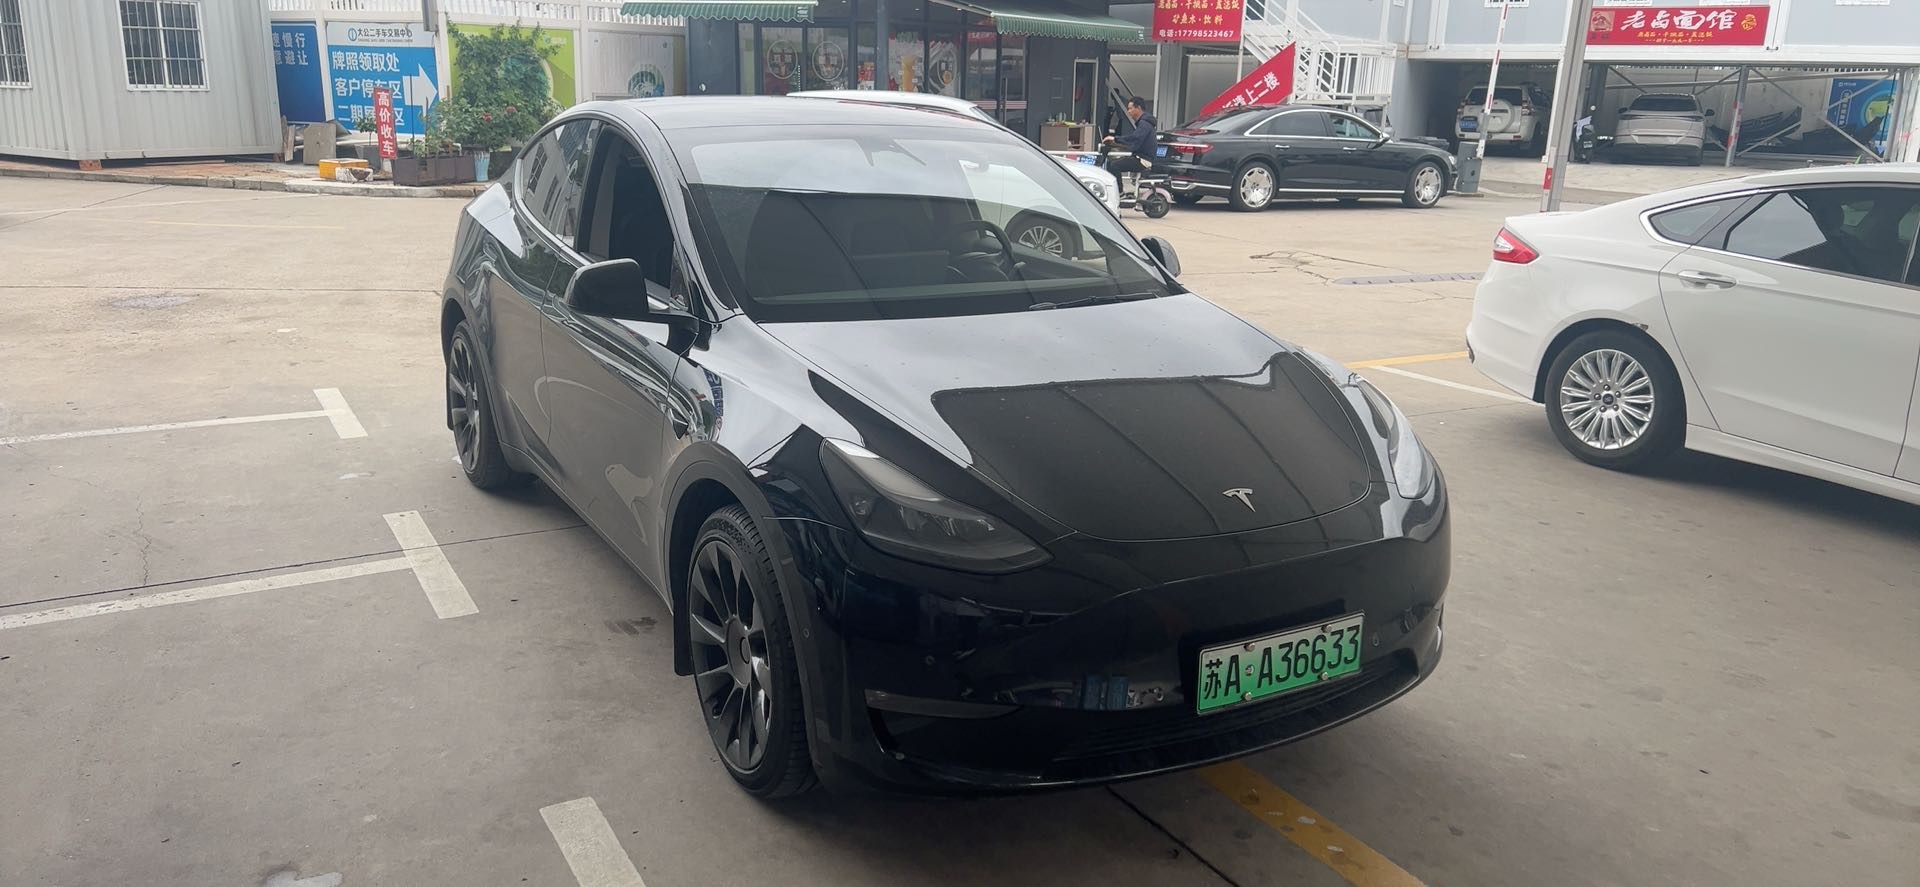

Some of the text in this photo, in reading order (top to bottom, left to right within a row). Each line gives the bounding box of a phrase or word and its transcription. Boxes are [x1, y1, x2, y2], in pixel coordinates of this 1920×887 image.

[1620, 9, 1737, 31] 老卤面馆
[357, 27, 413, 38] 大公二手车交易中心
[332, 51, 400, 72] 牌照领取处
[377, 91, 395, 155] 高价收车
